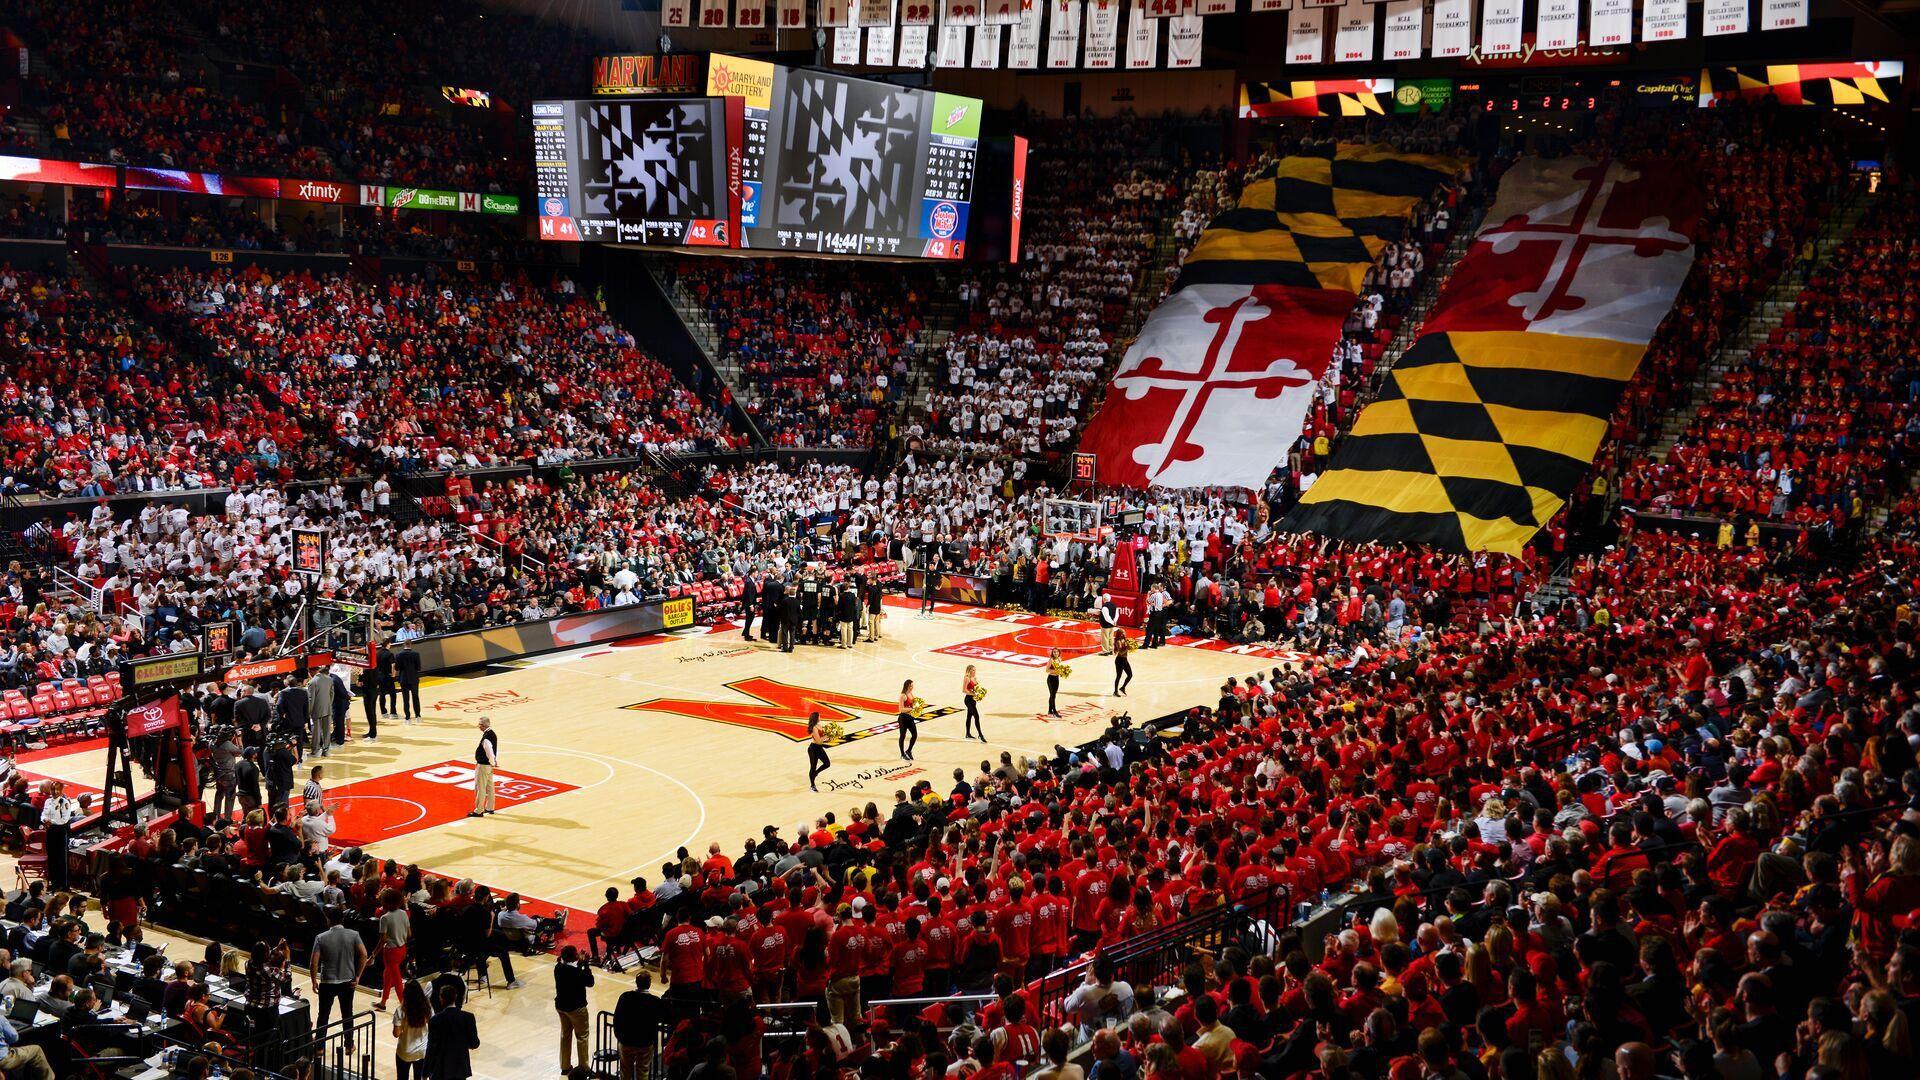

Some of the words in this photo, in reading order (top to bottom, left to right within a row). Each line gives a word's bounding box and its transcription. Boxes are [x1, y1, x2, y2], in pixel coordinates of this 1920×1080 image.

[1151, 0, 1177, 14] 44
[1769, 2, 1801, 10] CHAMPIONS
[669, 8, 682, 24] 25
[704, 9, 723, 25] 20
[1486, 17, 1520, 25] TOURNAMENT
[1541, 13, 1575, 22] TOURNAMENT
[1388, 24, 1420, 32] TOURNAMENT
[1436, 21, 1469, 29] TOURNAMENT
[592, 55, 701, 87] MARYLAND
[732, 71, 772, 87] MARYLAND
[1486, 100, 1494, 111] 2
[1511, 99, 1519, 110] 3
[1543, 96, 1551, 107] 2
[1561, 98, 1569, 109] 2
[1587, 97, 1595, 109] 3
[748, 133, 759, 142] 100
[729, 146, 741, 197] xfinity
[299, 182, 342, 202] xfinity
[366, 186, 379, 204] M
[418, 194, 429, 205] DO
[440, 195, 457, 207] DEW
[463, 193, 476, 210] M
[1013, 178, 1023, 220] xfinity
[542, 218, 555, 236] M
[560, 223, 574, 235] 41
[583, 227, 591, 236] 2
[596, 227, 603, 236] 3
[619, 222, 644, 234] 14:44
[662, 228, 669, 238] 2
[673, 228, 681, 238] 3
[691, 226, 707, 239] 42
[781, 238, 787, 247] 3
[795, 239, 801, 248] 2
[824, 232, 858, 250] 14:44
[877, 244, 883, 252] 3
[890, 245, 897, 253] 2
[930, 239, 945, 257] 42
[214, 252, 229, 261] 126
[1077, 456, 1094, 464] 14:44
[1077, 464, 1091, 479] 30
[664, 601, 692, 615] OLLIE'S
[667, 611, 688, 620] BARGAIN
[669, 617, 687, 625] OUTLET
[210, 638, 226, 651] 30
[174, 666, 195, 675] OUTLET
[424, 690, 520, 711] xfinity
[143, 719, 167, 730] TOYOTA
[835, 1034, 848, 1051] 1
[1017, 1033, 1035, 1056] 11
